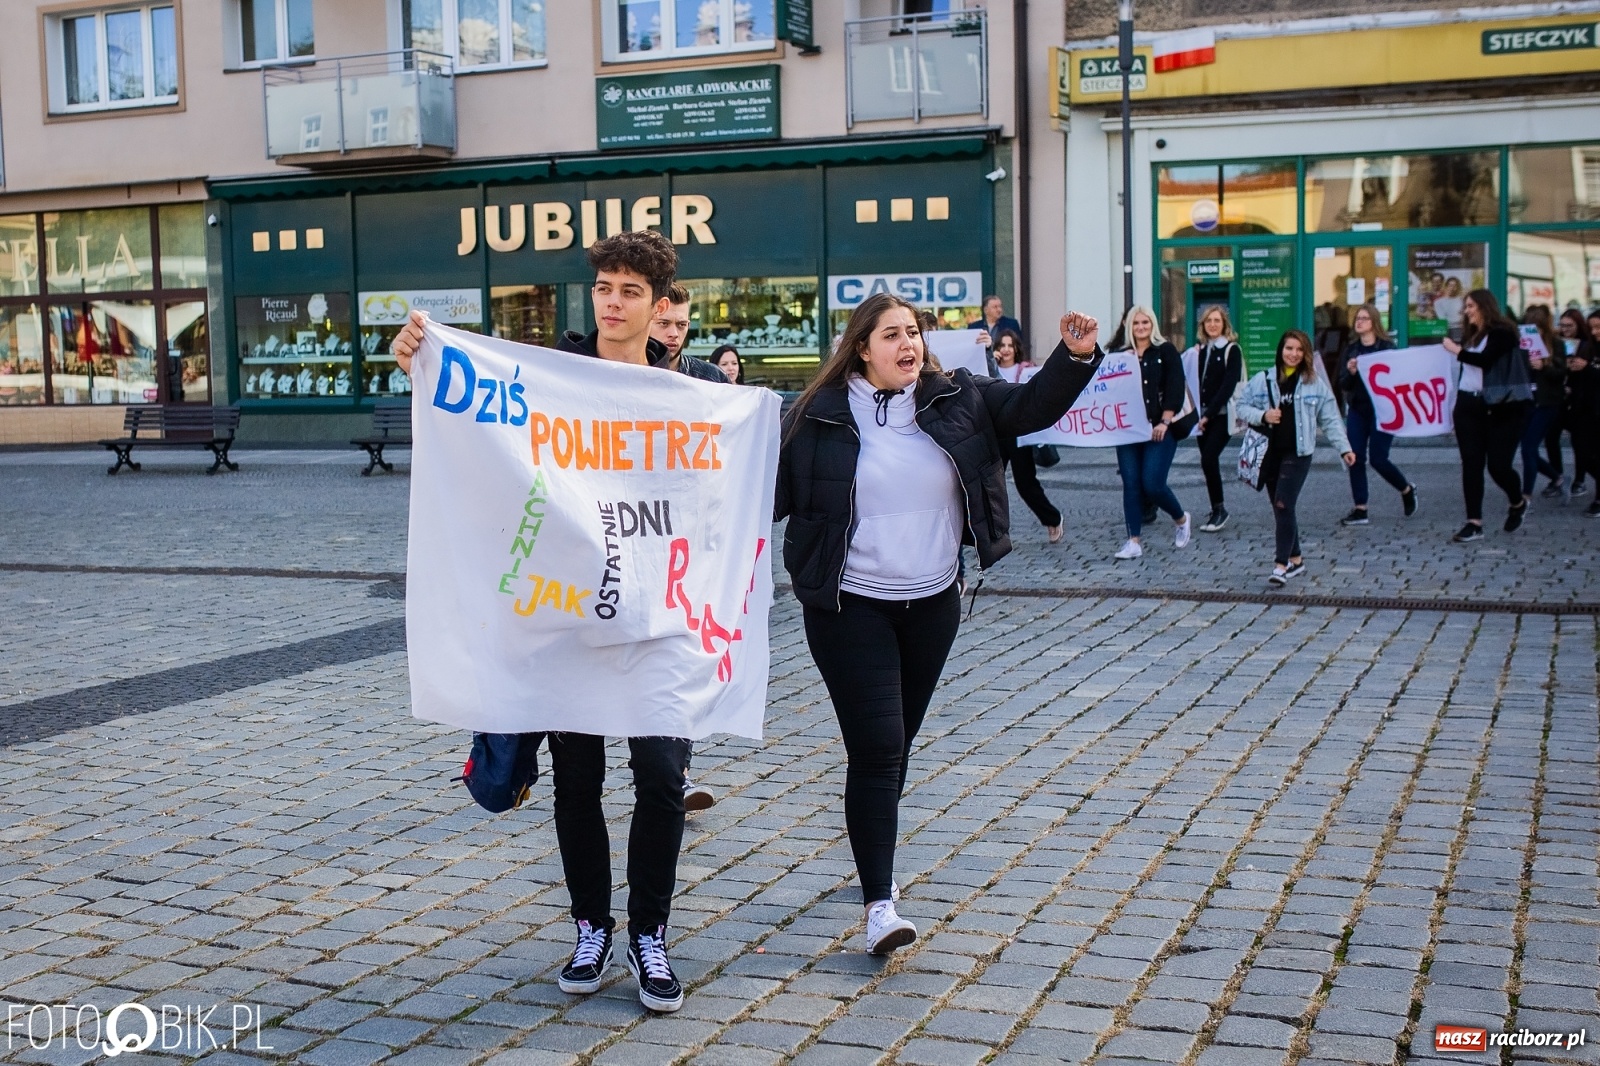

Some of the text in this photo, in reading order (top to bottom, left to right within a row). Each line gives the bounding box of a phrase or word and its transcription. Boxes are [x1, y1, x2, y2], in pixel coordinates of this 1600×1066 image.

[1489, 28, 1589, 51] STEFCZYK
[1101, 58, 1144, 73] KAA
[626, 79, 772, 100] KANCELARIE ADWOKACKIE
[1082, 77, 1143, 91] STEFCZKA
[0, 233, 140, 282] ELLA
[413, 295, 467, 308] Obrączki do
[837, 276, 967, 304] CASIO
[262, 297, 289, 309] Pierre
[266, 303, 298, 322] Ricaud
[444, 302, 480, 318] -30%
[1054, 400, 1133, 435] OTEŚCIE
[530, 412, 722, 472] POWIETRZE
[617, 500, 673, 538] DNI
[595, 501, 621, 620] OSTATNIE
[513, 574, 593, 618] JAK
